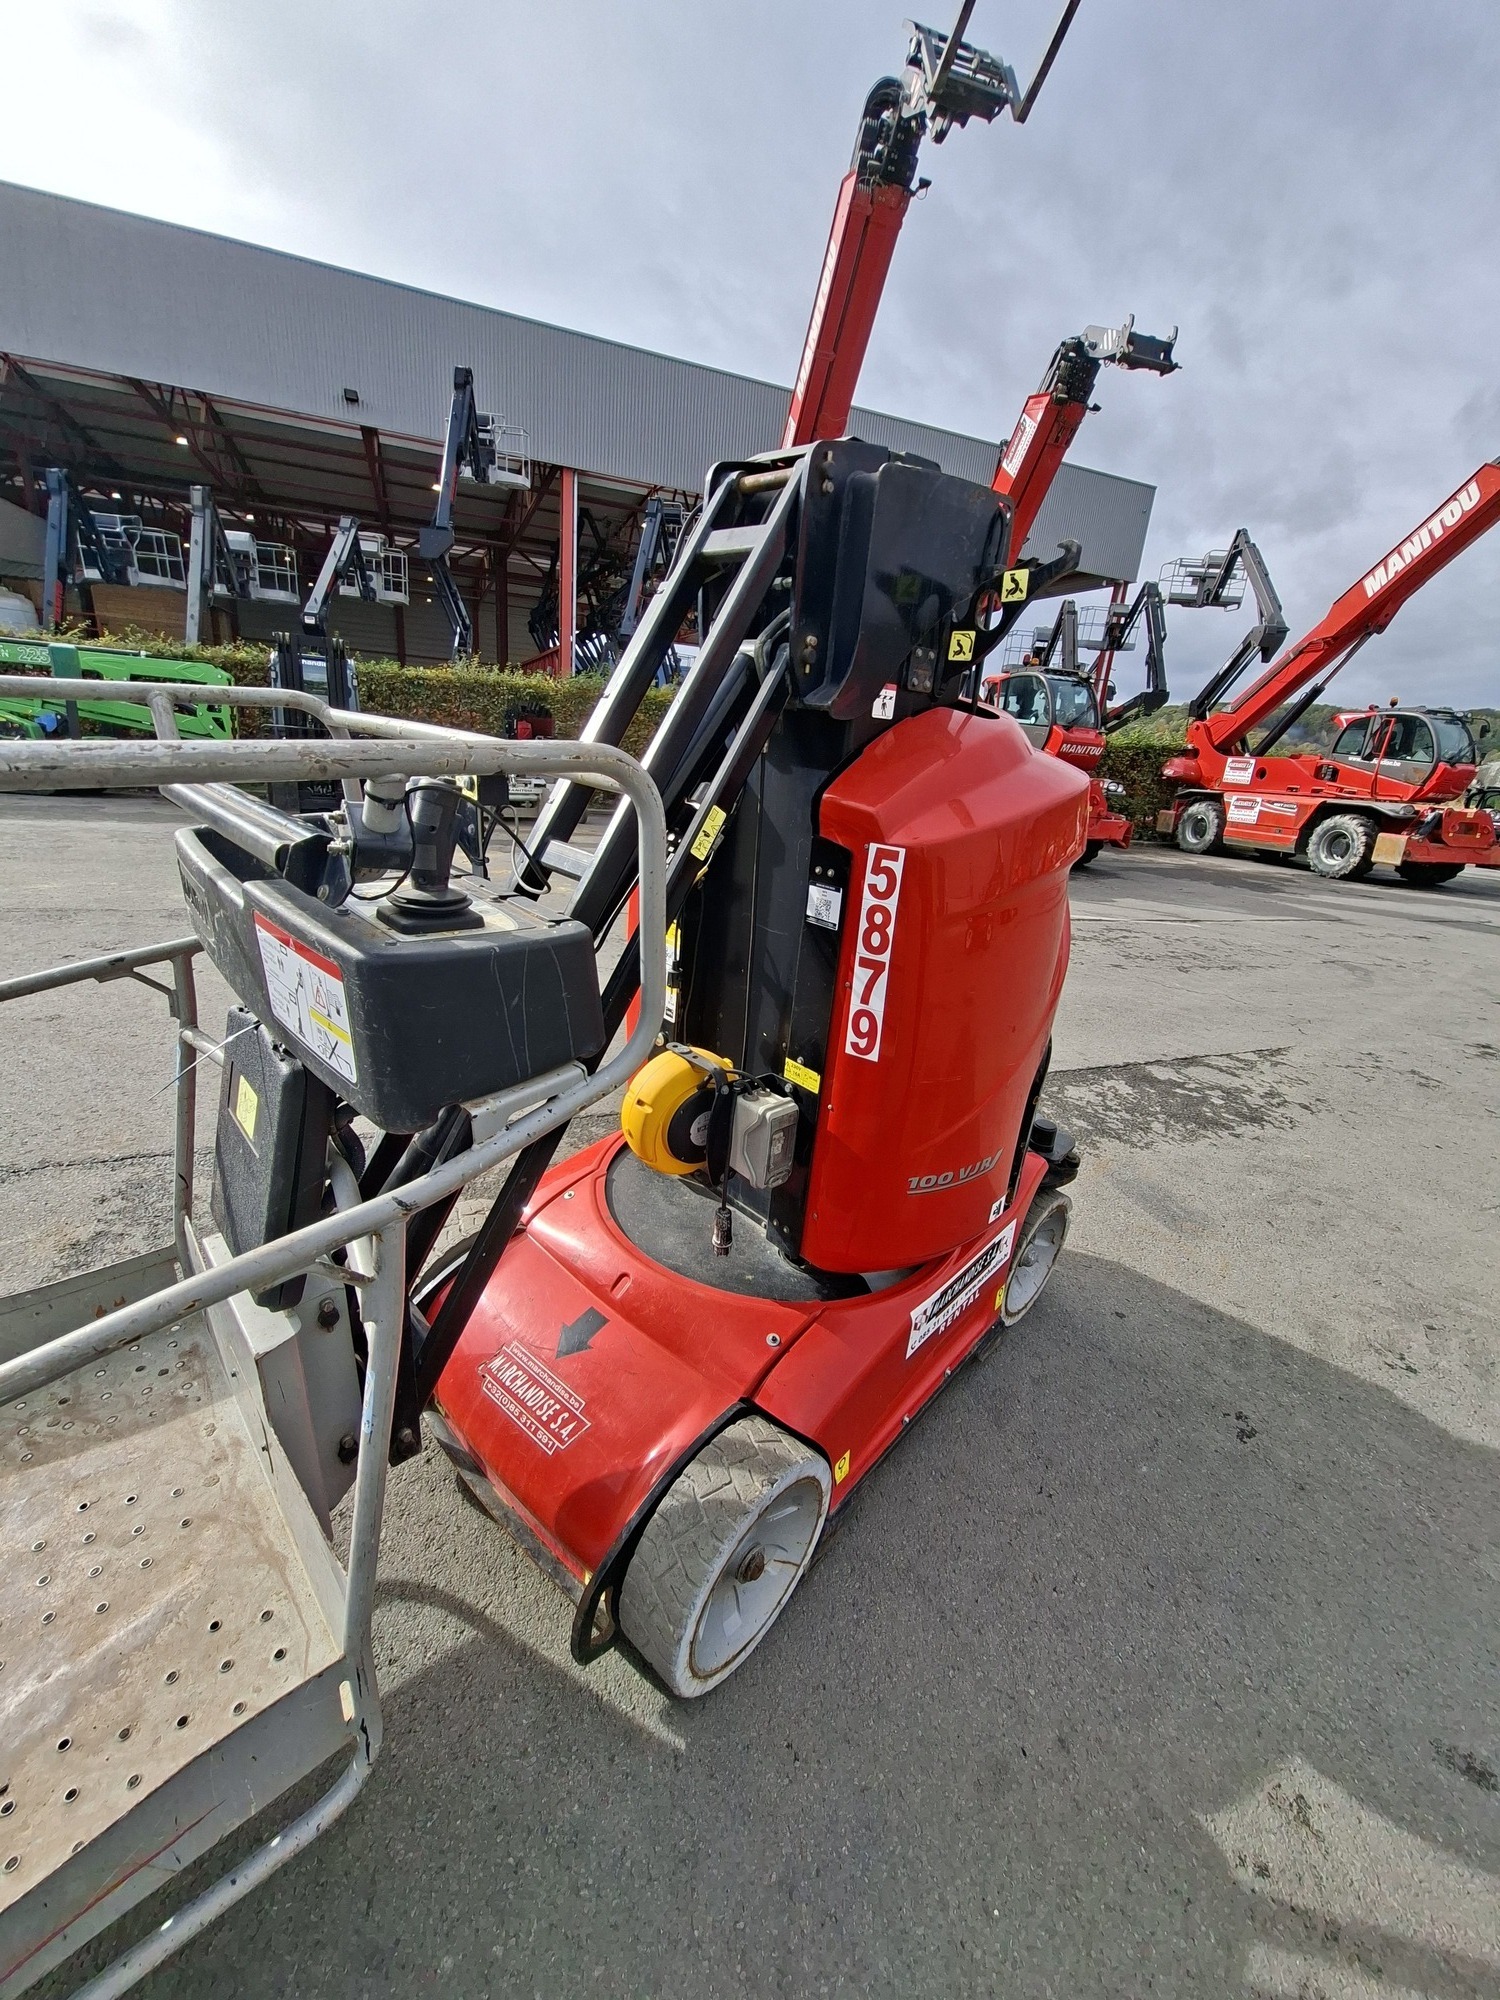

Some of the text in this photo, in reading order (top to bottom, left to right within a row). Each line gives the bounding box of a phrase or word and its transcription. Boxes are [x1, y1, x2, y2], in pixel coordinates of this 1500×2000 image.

[796, 239, 836, 401] MANITOU
[1363, 479, 1481, 598] MANITOU
[17, 646, 51, 663] 225
[1060, 743, 1103, 756] MANITOU
[850, 847, 900, 1056] 5879
[908, 1156, 993, 1189] 100 VJR
[939, 1289, 980, 1335] RENTAL
[487, 1353, 561, 1421] MARCHANDISE
[511, 1345, 580, 1409] www.marchandise.be
[487, 1382, 553, 1448] +32(0)85 311 591
